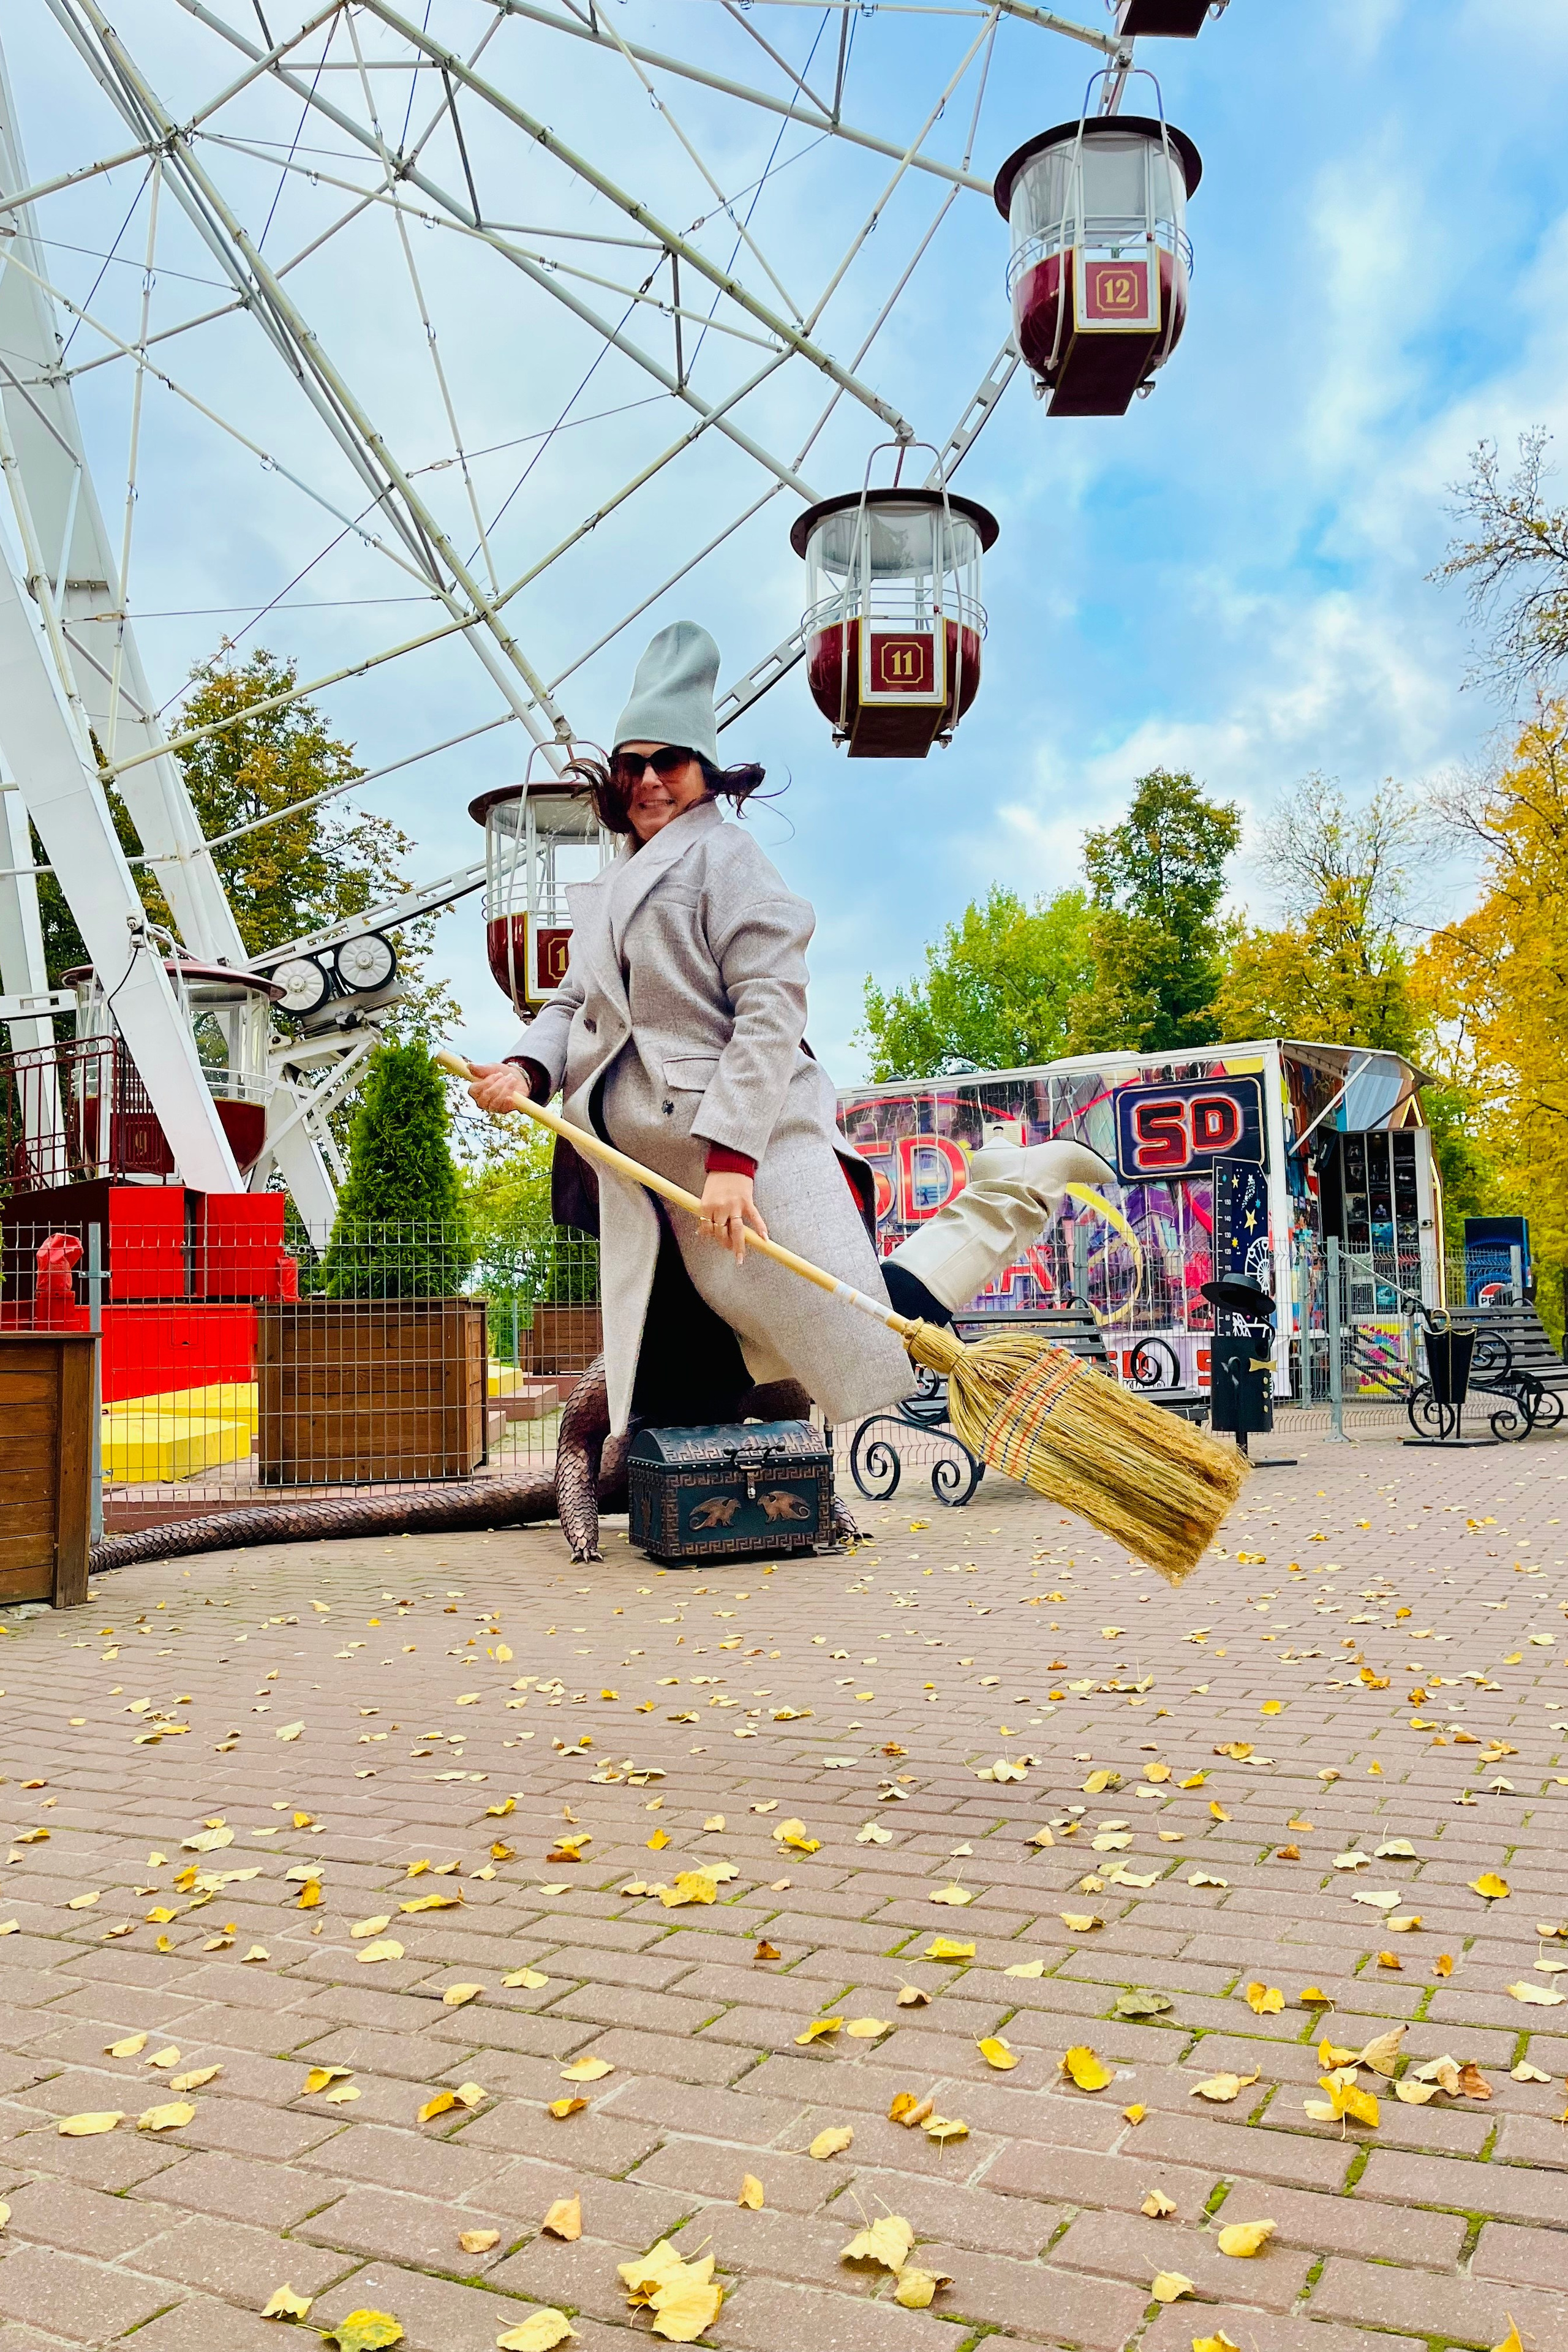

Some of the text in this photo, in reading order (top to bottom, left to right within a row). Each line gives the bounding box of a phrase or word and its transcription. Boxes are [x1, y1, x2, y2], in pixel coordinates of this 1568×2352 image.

[1104, 278, 1130, 303] 12
[891, 650, 913, 675] 11
[556, 946, 567, 971] 1
[1135, 1096, 1238, 1167] 5D
